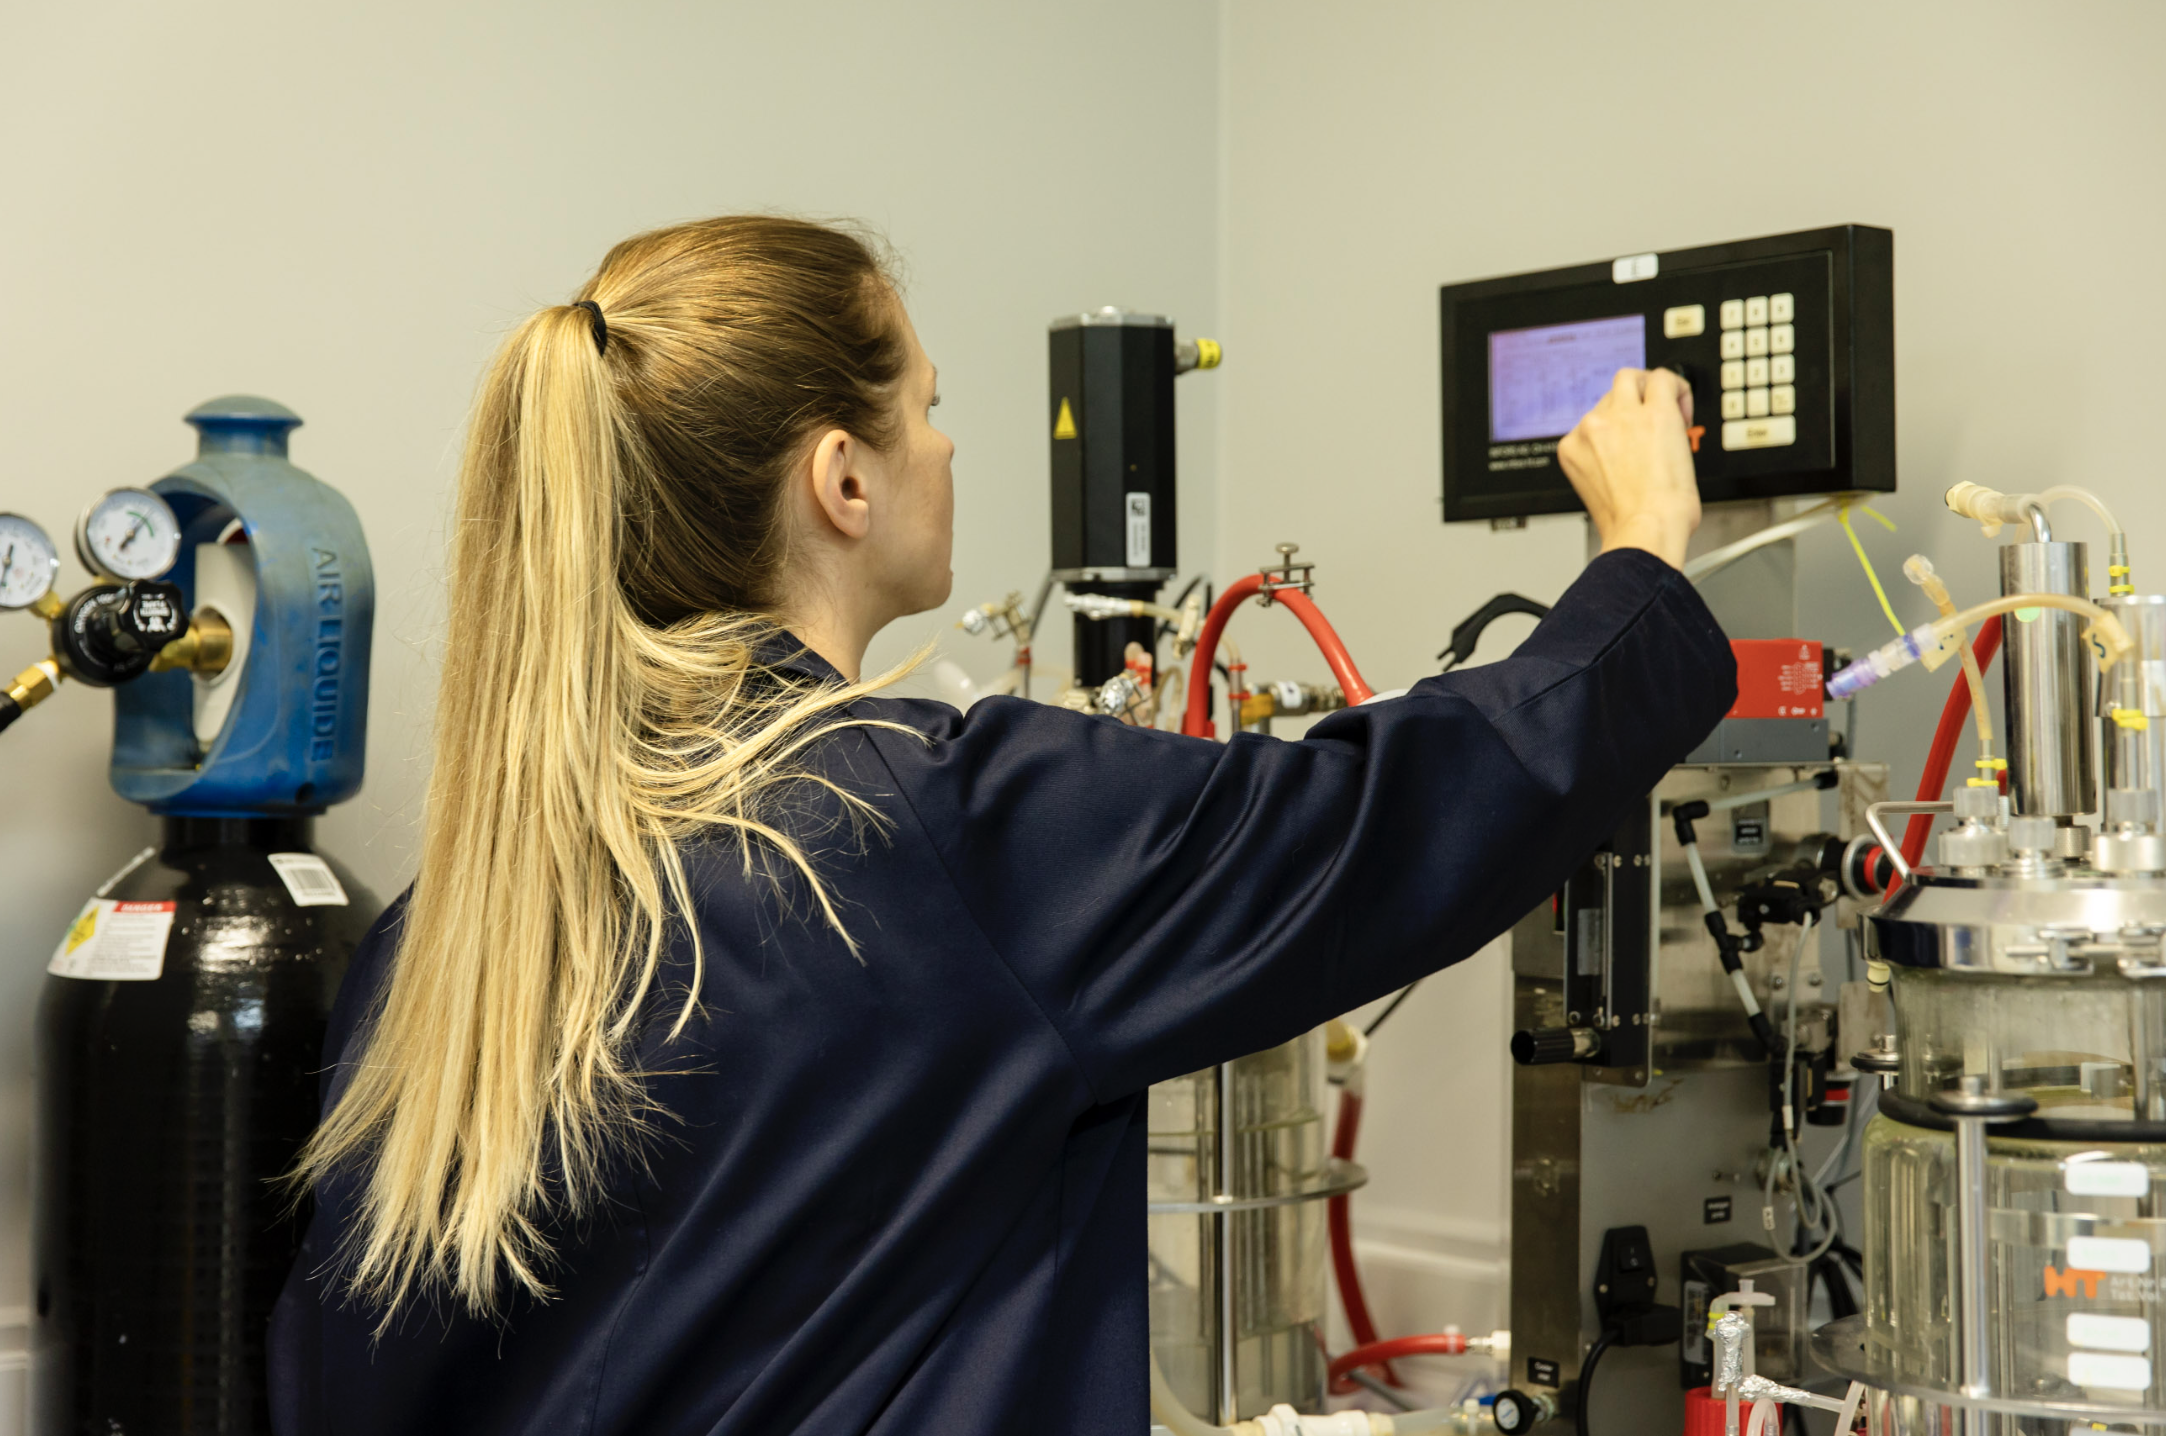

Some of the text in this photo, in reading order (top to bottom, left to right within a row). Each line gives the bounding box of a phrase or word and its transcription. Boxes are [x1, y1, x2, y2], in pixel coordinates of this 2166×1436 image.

[1746, 428, 1768, 438] Enter
[311, 547, 342, 762] AIR LIQUIDE
[119, 902, 164, 912] DANGER
